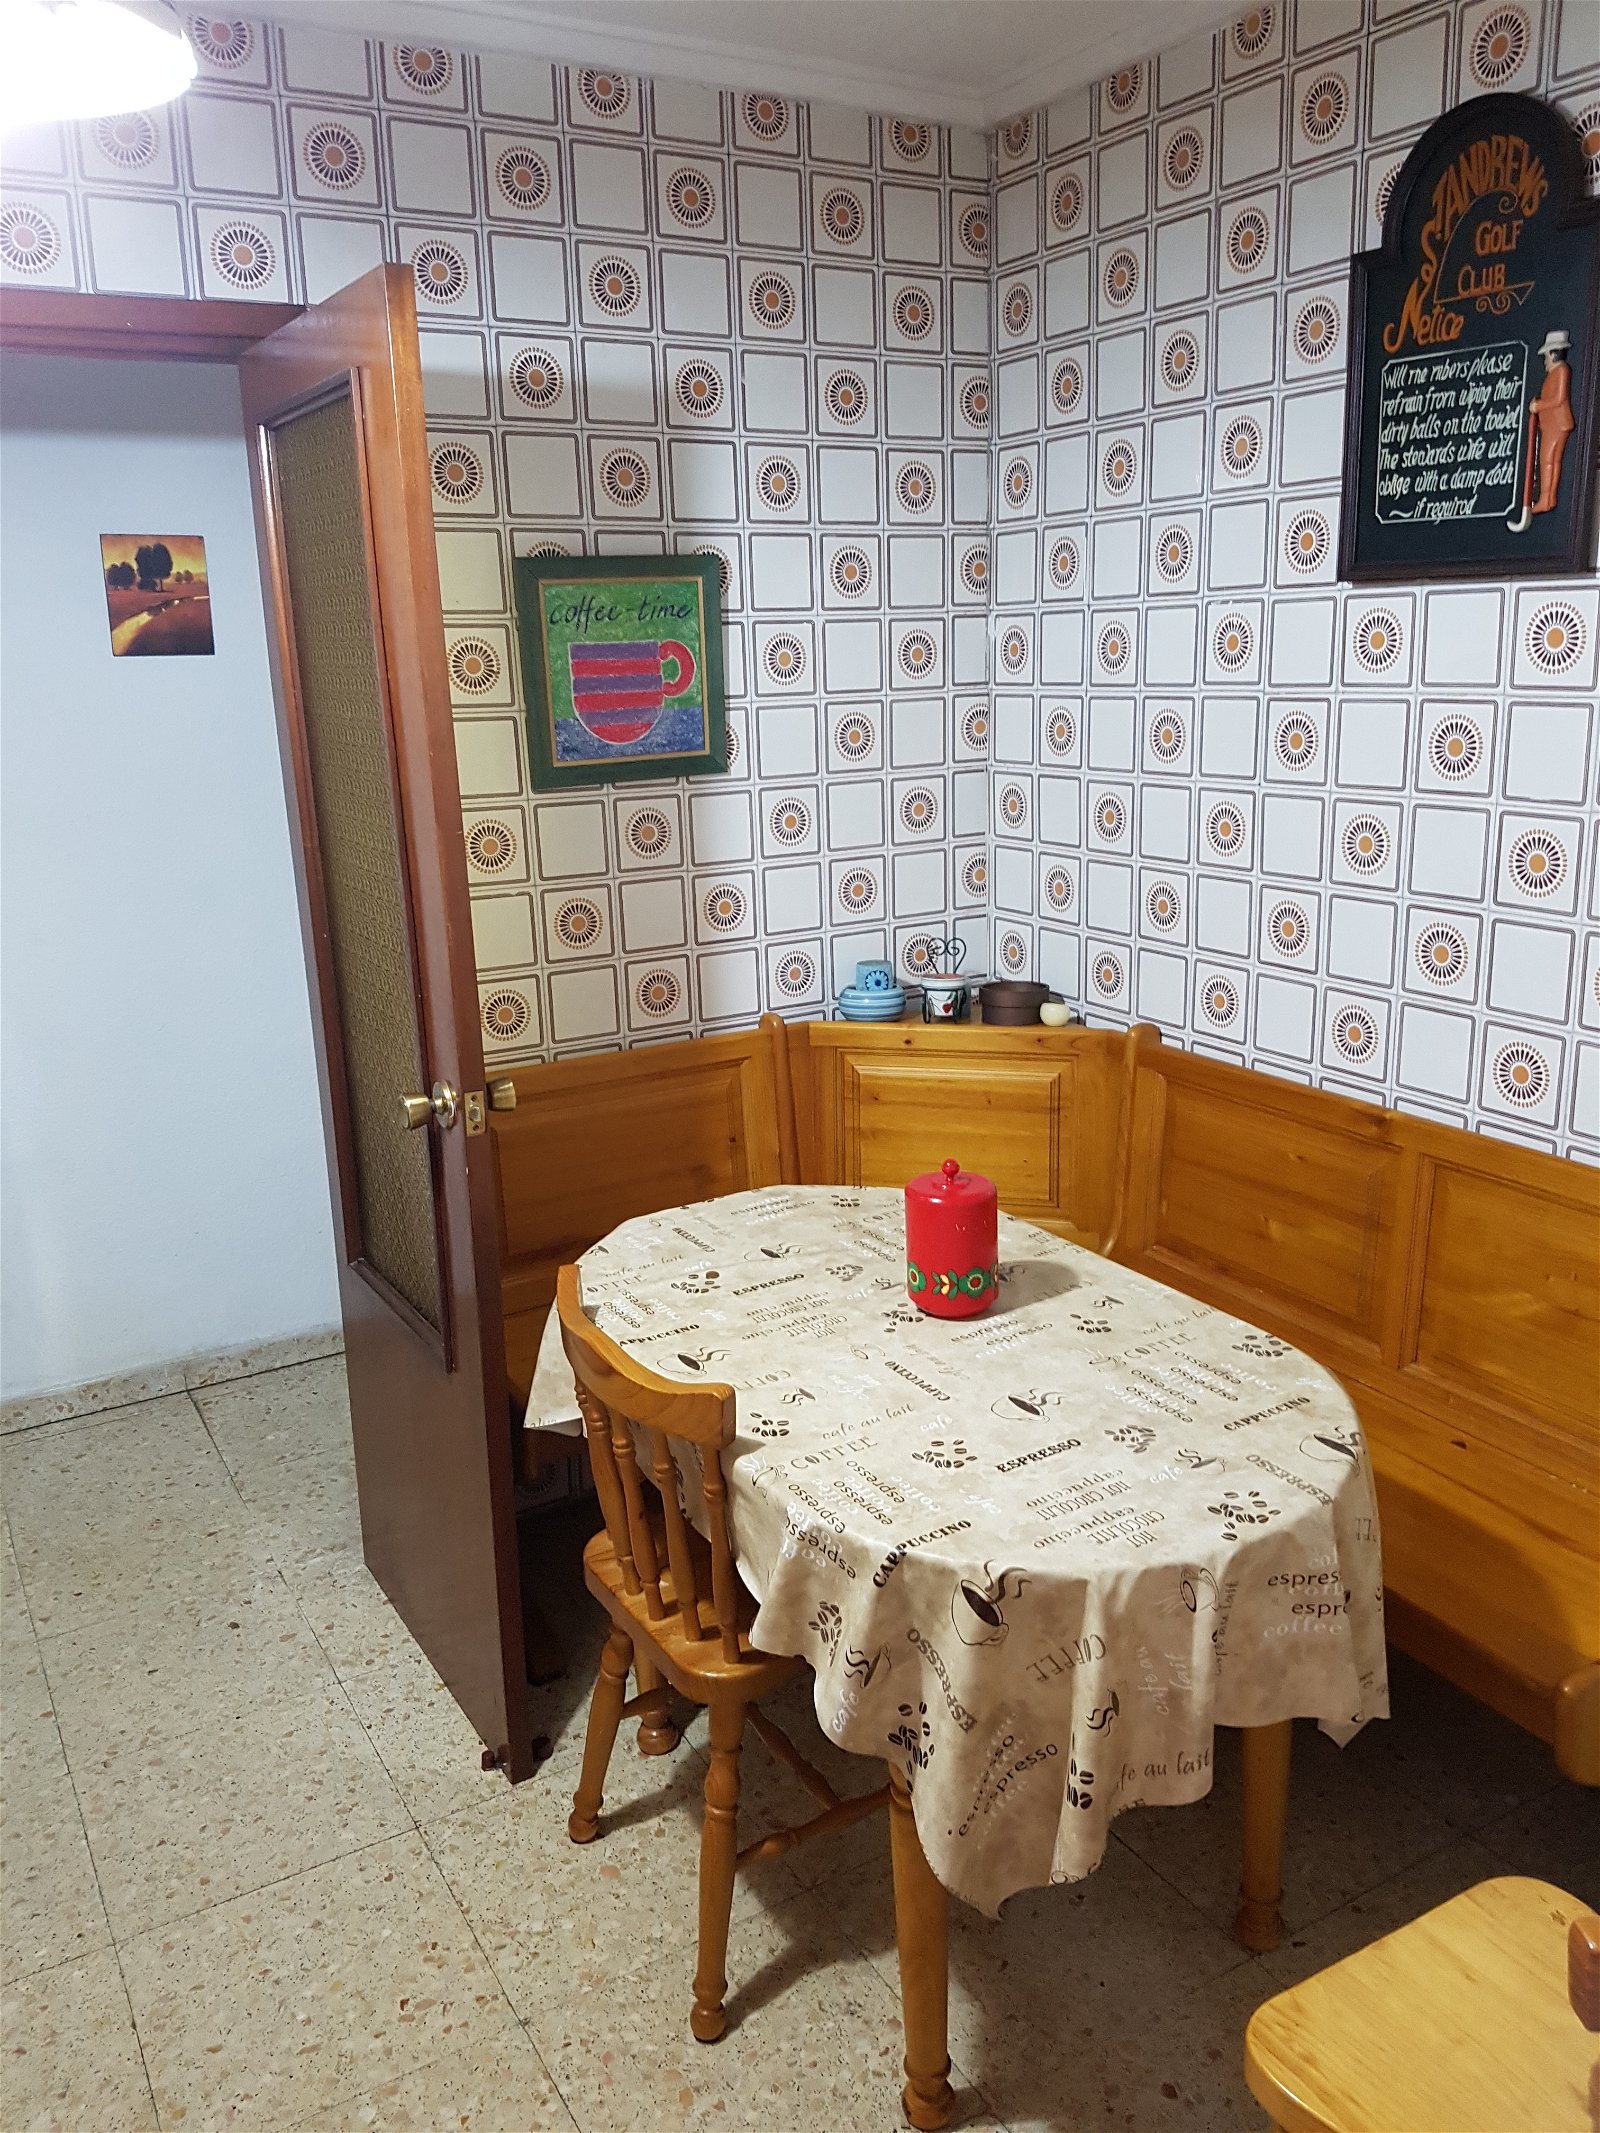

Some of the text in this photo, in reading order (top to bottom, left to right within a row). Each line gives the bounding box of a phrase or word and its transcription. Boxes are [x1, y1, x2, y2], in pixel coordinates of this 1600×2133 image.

[1475, 219, 1524, 256] GOLF
[1458, 263, 1505, 298] CLUB
[1384, 364, 1408, 389] Will
[1466, 349, 1513, 382] please
[1382, 376, 1522, 417] refrain from wiping their
[1381, 404, 1520, 448] dirty balls on the towel
[1379, 432, 1516, 470] The stewards wife will
[1378, 473, 1411, 500] oblige
[1414, 469, 1437, 493] with
[1439, 473, 1448, 491] a
[1450, 467, 1485, 493] damp
[1414, 497, 1426, 518] if
[732, 1273, 805, 1296] ESPRESSO
[619, 1324, 700, 1347] APPUCCINO
[951, 1319, 1019, 1343] espresso
[986, 1322, 1053, 1346] espresso
[884, 1360, 951, 1401] CAPPUCCINO
[1171, 1366, 1239, 1401] espresso
[1175, 1351, 1242, 1384] espresso
[1126, 1386, 1193, 1423] espresso
[1131, 1369, 1197, 1405] espresso
[822, 1403, 914, 1440] cafe au lait
[1223, 1396, 1310, 1431] CAPPUCCINO
[790, 1435, 878, 1469] COFFEE
[995, 1438, 1081, 1473] ESPRESSO
[846, 1460, 905, 1503] espresso
[1026, 1469, 1123, 1508] cappuccino
[1149, 1465, 1184, 1484] cafe
[1245, 1454, 1334, 1504] ESPRESSO
[788, 1484, 846, 1534] espresso
[834, 1480, 893, 1525] espresso
[1036, 1489, 1105, 1521] CHOCOLAT
[1033, 1506, 1135, 1549] cappuccino
[1087, 1510, 1165, 1545] CHOCOLATE
[1126, 1530, 1158, 1548] HOT
[873, 1520, 972, 1588] CAPPUCCINO
[1264, 1615, 1342, 1640] coffee
[1025, 1634, 1106, 1682] COFFEE
[906, 1628, 978, 1734] ESPRESSO
[1144, 1762, 1166, 1778] au
[1177, 1746, 1210, 1776] lait
